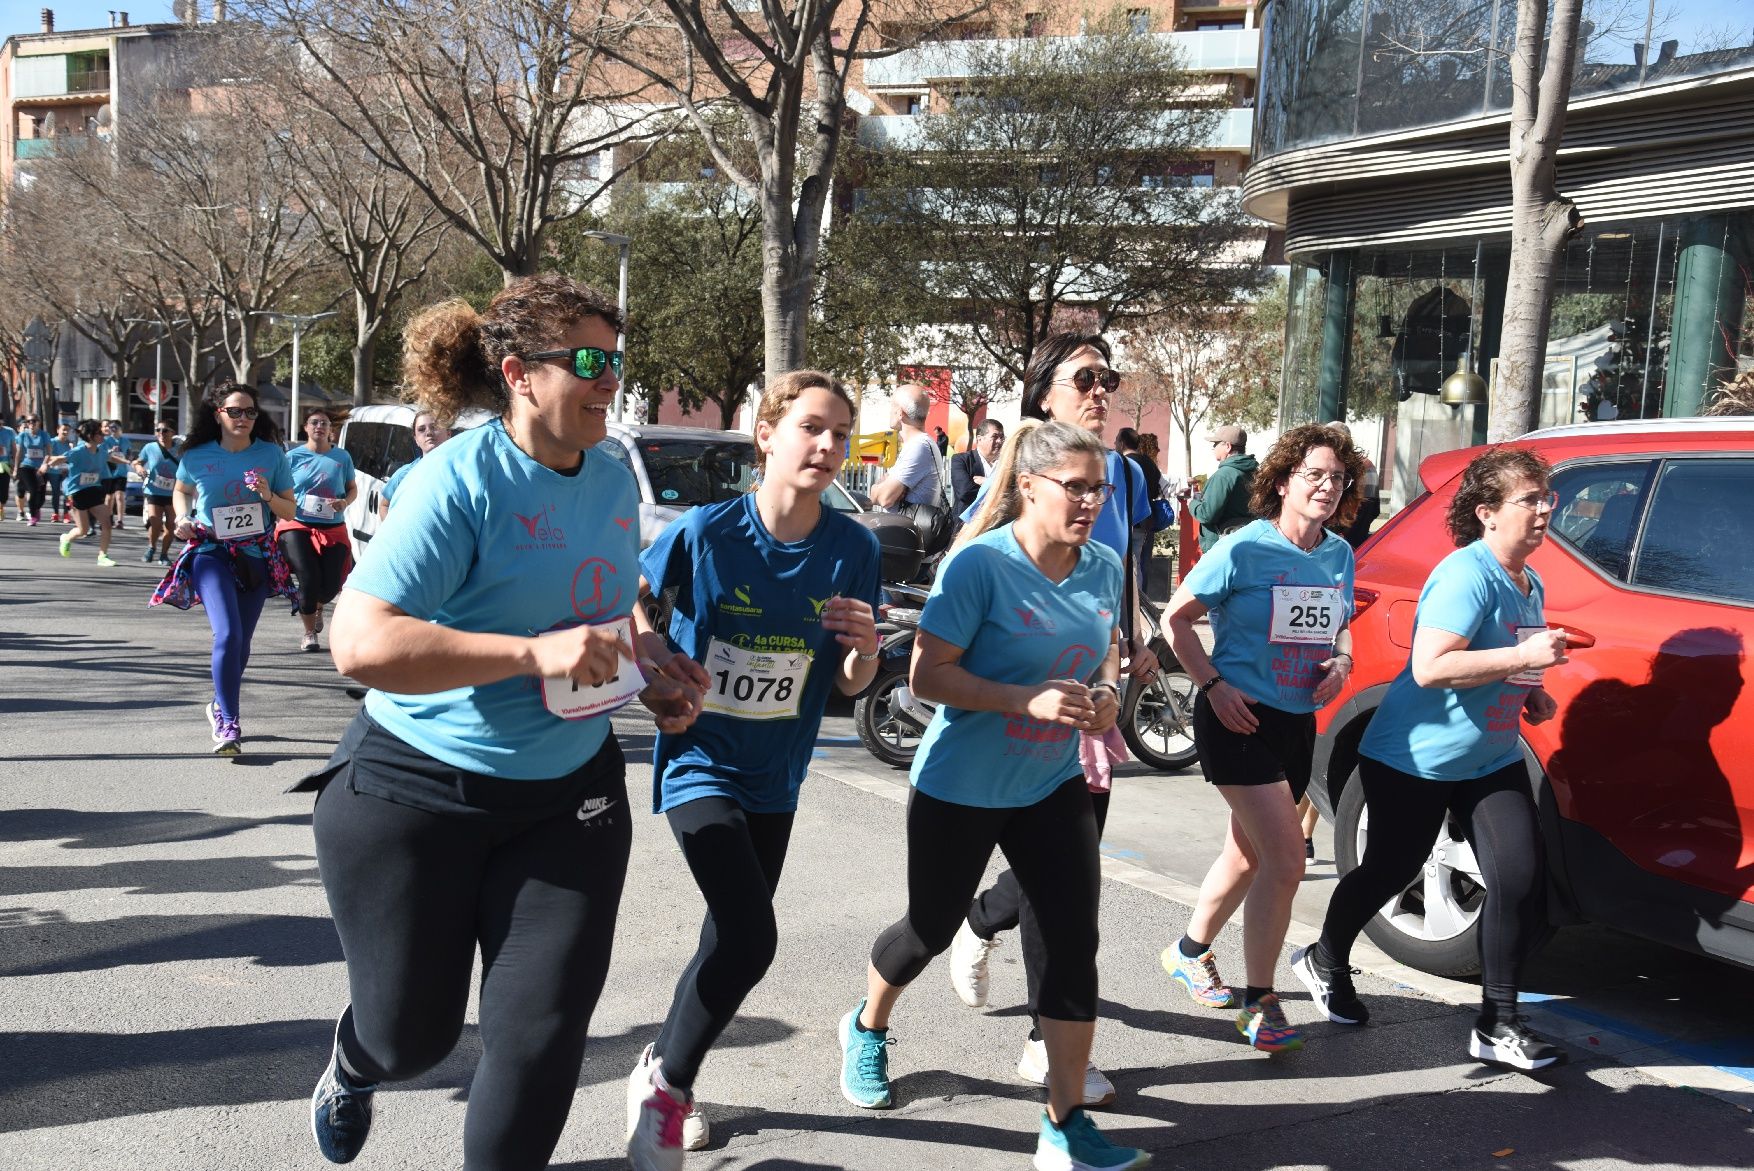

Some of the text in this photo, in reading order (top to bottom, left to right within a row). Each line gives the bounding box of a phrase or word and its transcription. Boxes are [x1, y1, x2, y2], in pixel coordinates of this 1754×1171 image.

[224, 513, 254, 530] 722
[1289, 605, 1331, 629] 255
[754, 634, 806, 649] 4a CURSA
[1271, 657, 1292, 673] DE
[1293, 660, 1312, 675] LA
[716, 669, 794, 702] 1078
[582, 796, 609, 811] NIKE
